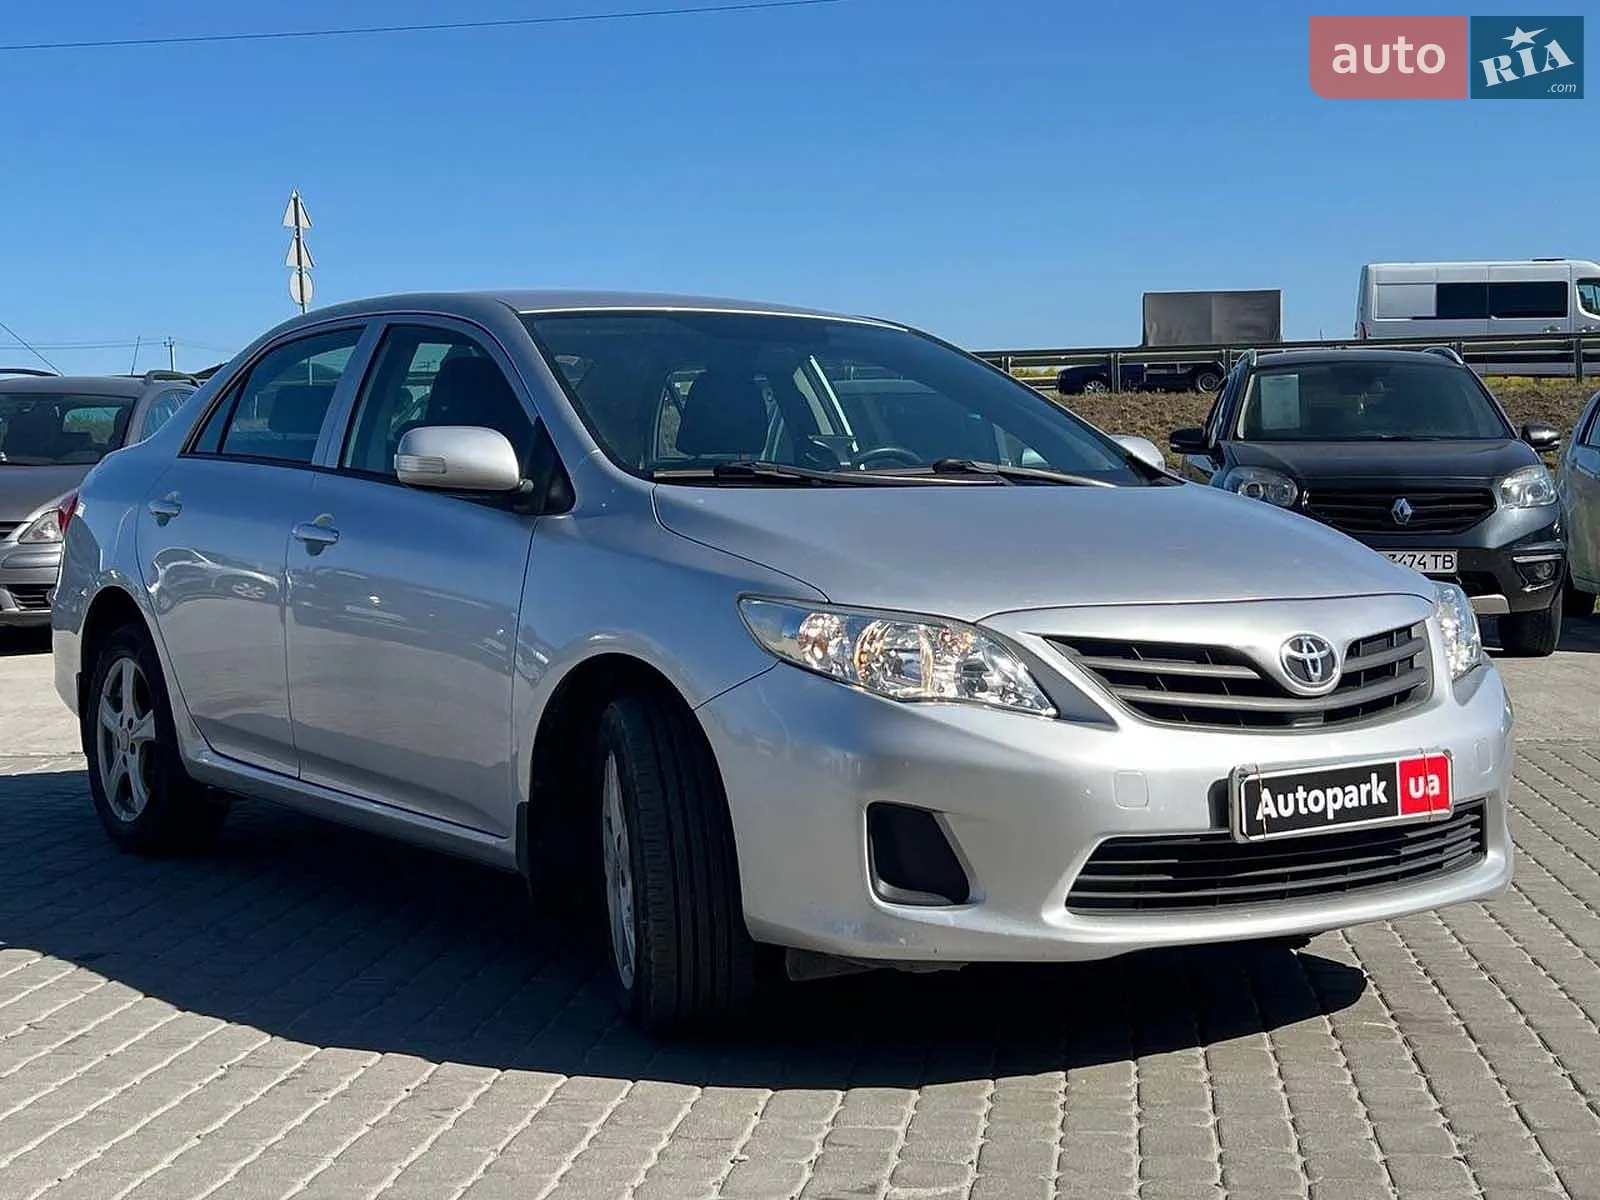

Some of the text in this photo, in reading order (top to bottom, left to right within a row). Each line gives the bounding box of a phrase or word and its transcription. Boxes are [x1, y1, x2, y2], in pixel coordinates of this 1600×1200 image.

[1430, 554, 1455, 570] TB
[1255, 772, 1440, 821] Autopark ua
